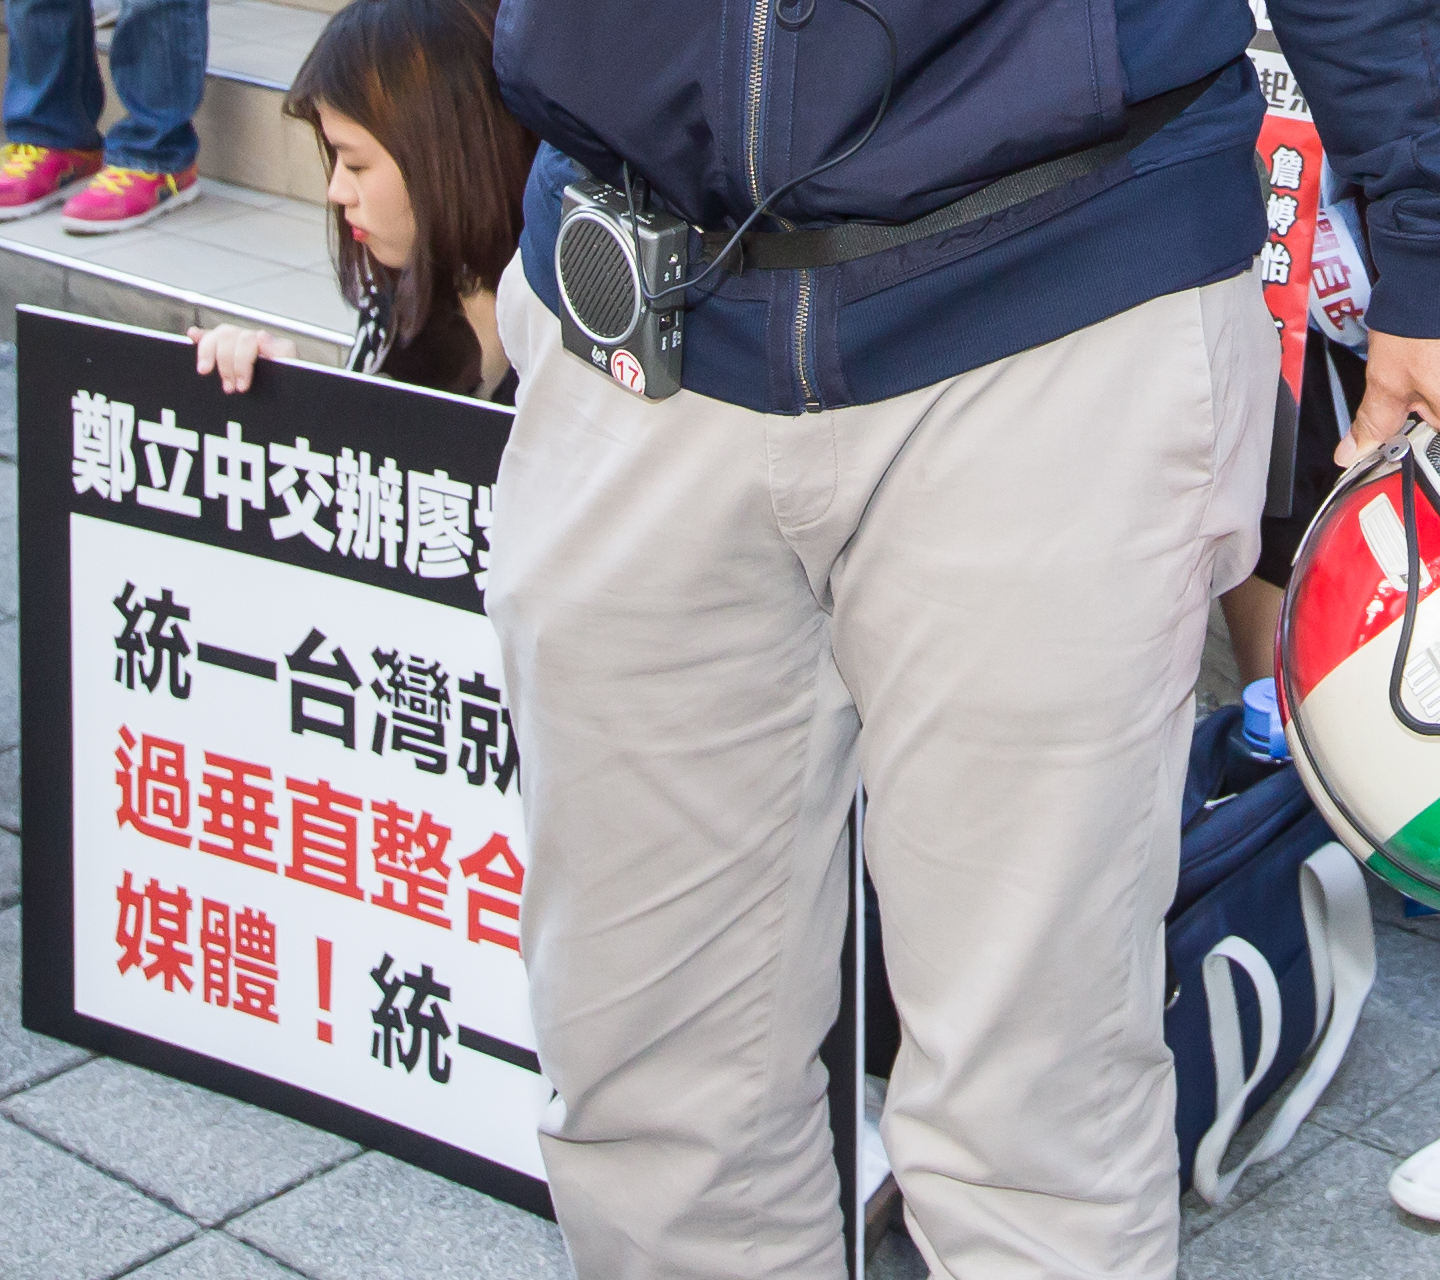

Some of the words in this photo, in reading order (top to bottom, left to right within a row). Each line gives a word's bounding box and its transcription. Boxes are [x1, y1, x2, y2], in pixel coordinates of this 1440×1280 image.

[114, 724, 524, 958] 過垂直整合
